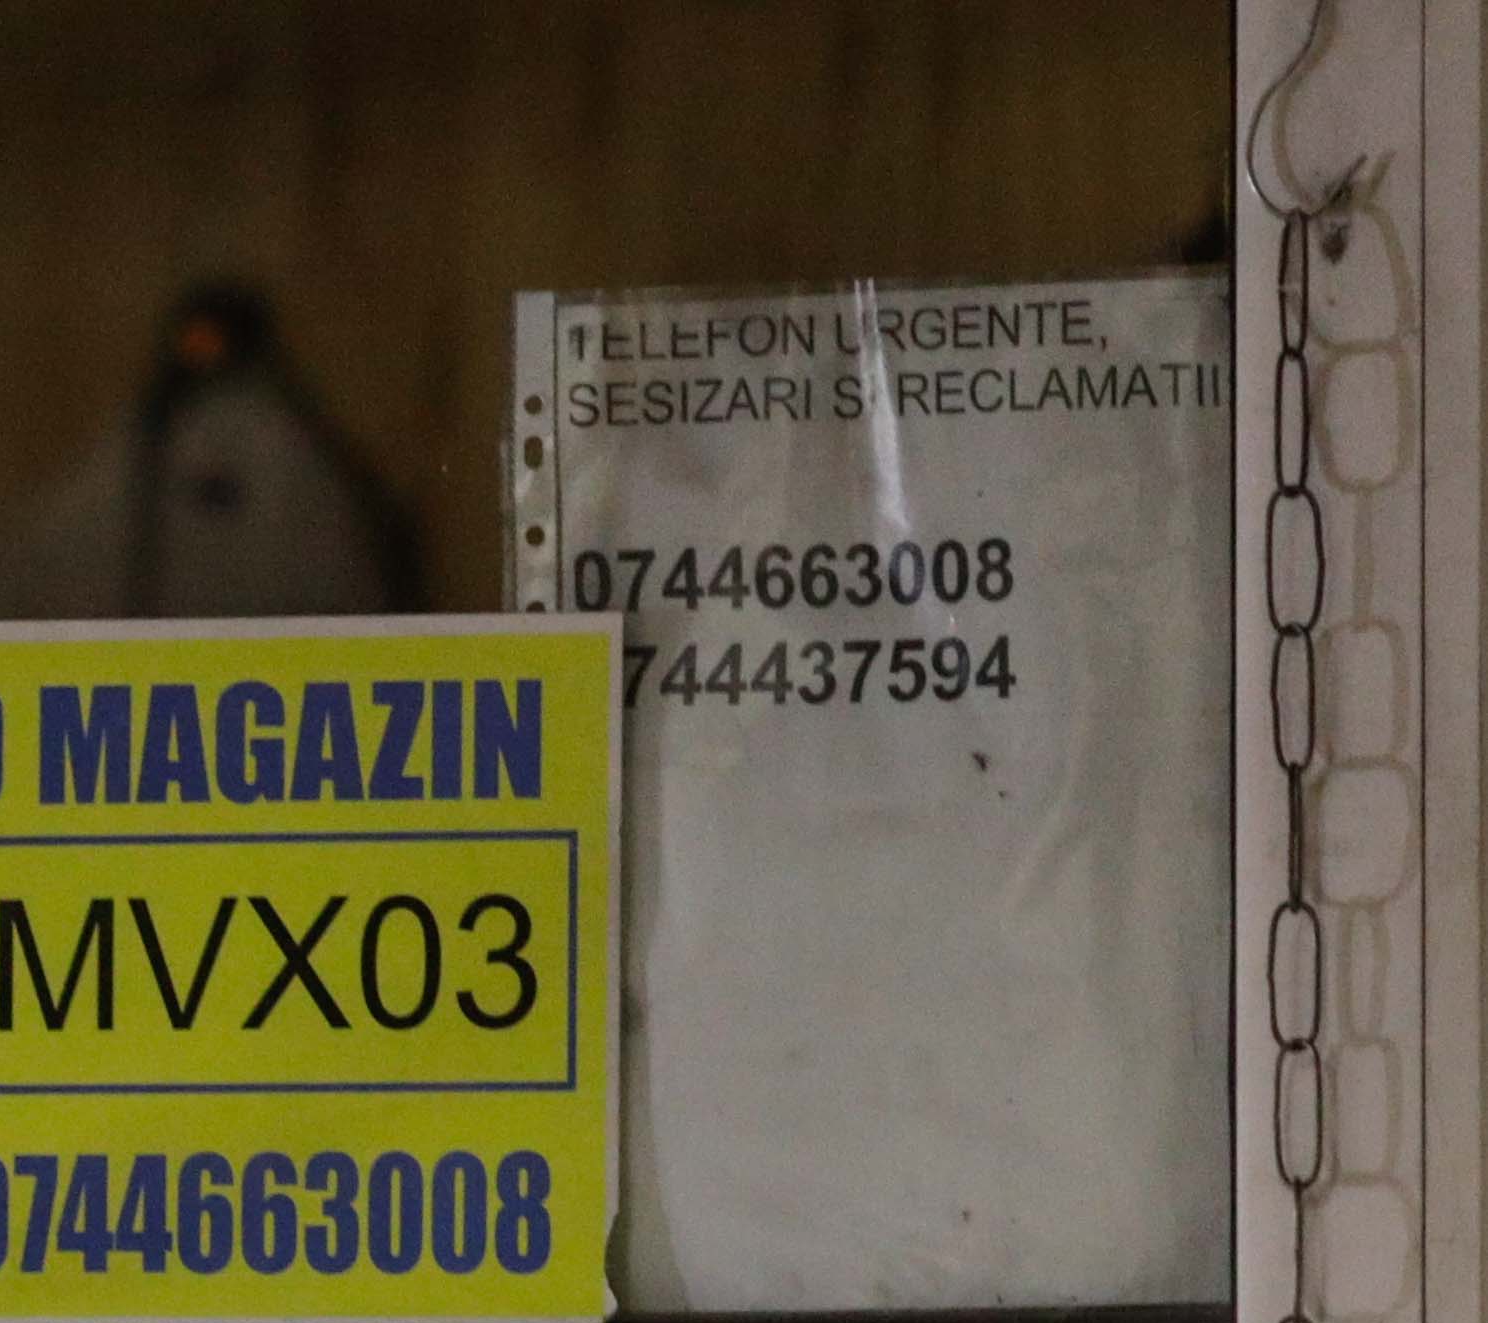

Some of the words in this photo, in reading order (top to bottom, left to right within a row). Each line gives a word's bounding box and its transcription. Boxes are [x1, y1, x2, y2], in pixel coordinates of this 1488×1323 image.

[568, 313, 816, 361] TELEFON
[835, 300, 1108, 354] URGENTE,
[568, 374, 812, 428] SESIZARI
[897, 361, 1221, 418] RECLAMATII
[572, 537, 1015, 612] 0744663008
[623, 633, 1017, 708] 744437594
[37, 677, 544, 805] MAGAZIN
